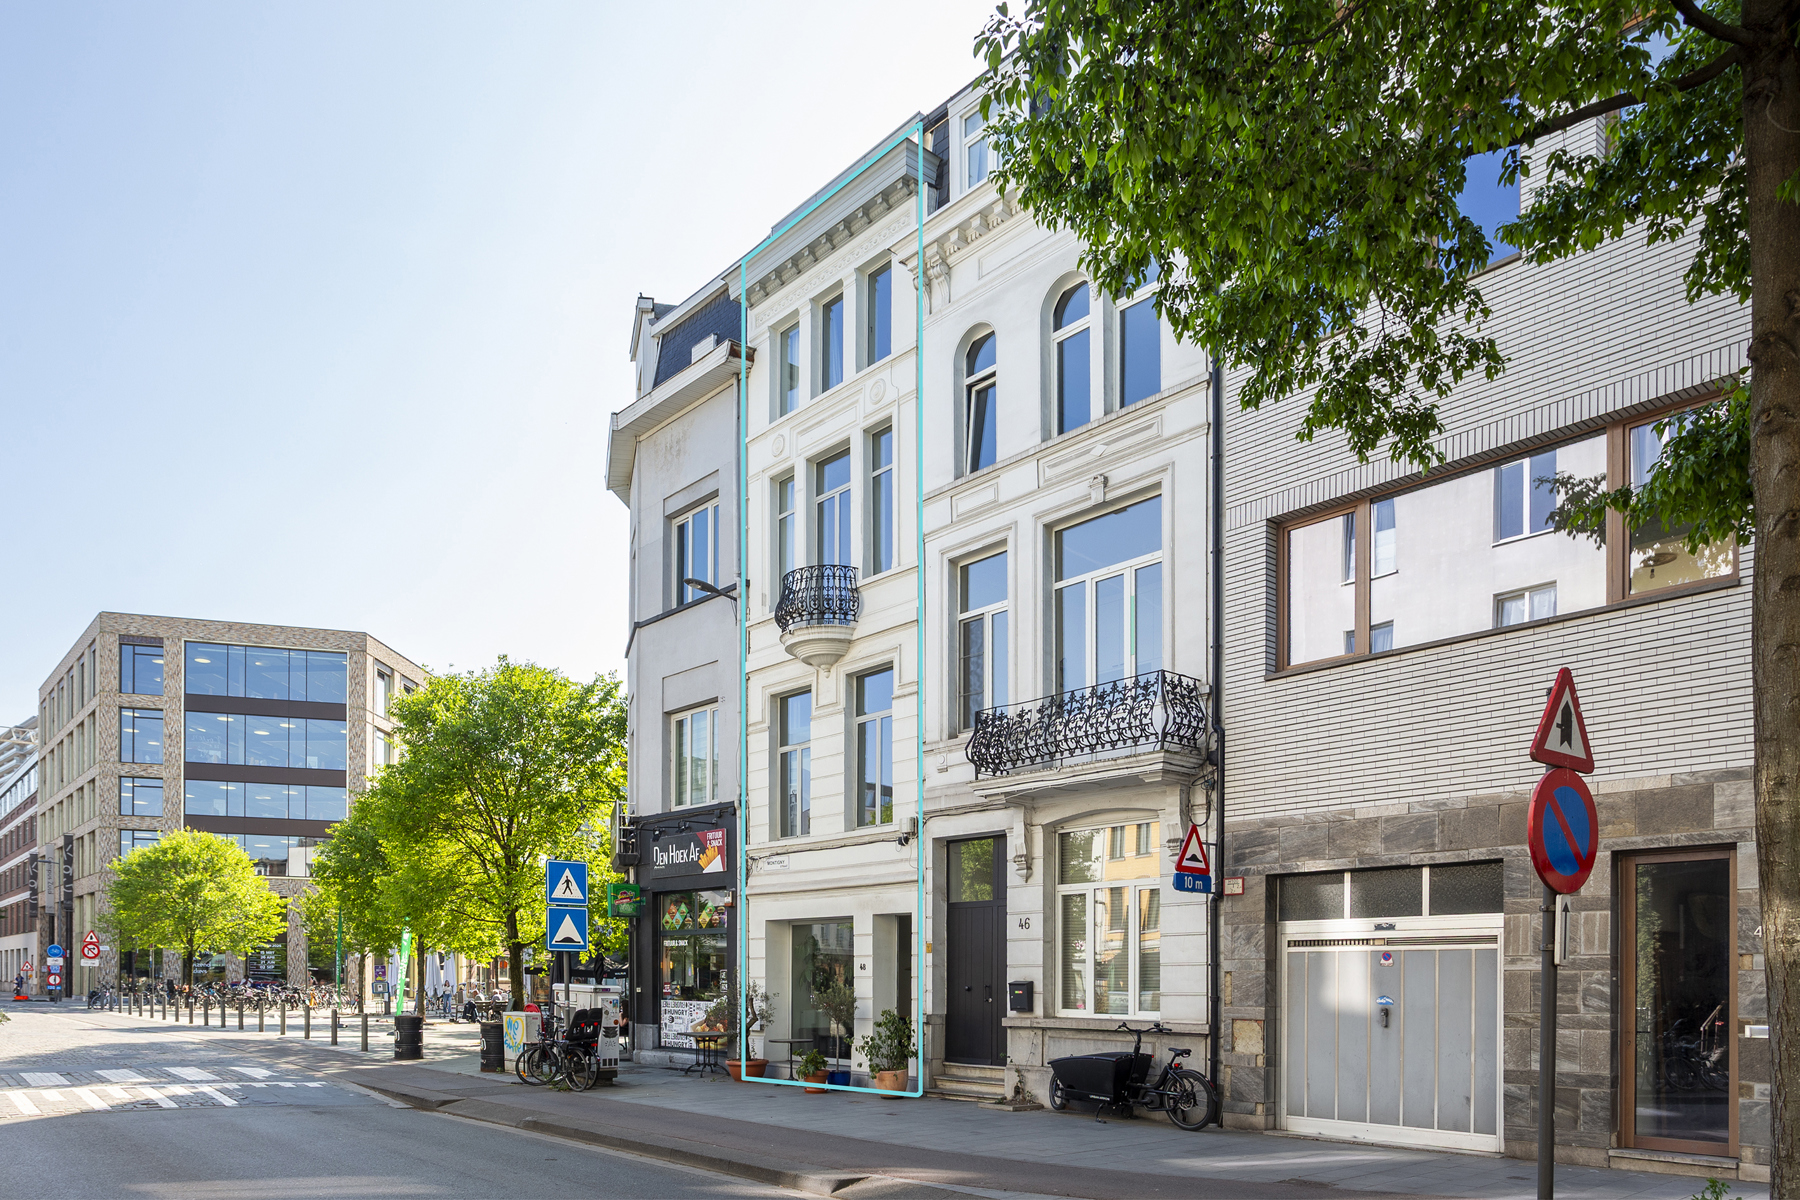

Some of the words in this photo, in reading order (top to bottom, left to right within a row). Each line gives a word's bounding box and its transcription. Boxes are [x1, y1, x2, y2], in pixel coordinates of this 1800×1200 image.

[706, 831, 723, 841] FRITUUR
[711, 839, 723, 848] SNACK
[653, 846, 668, 866] DEN
[669, 844, 689, 864] HOEK
[689, 842, 701, 862] AF
[1185, 875, 1193, 889] 10
[1196, 880, 1203, 890] m
[1019, 917, 1031, 930] 46
[859, 963, 867, 971] 48
